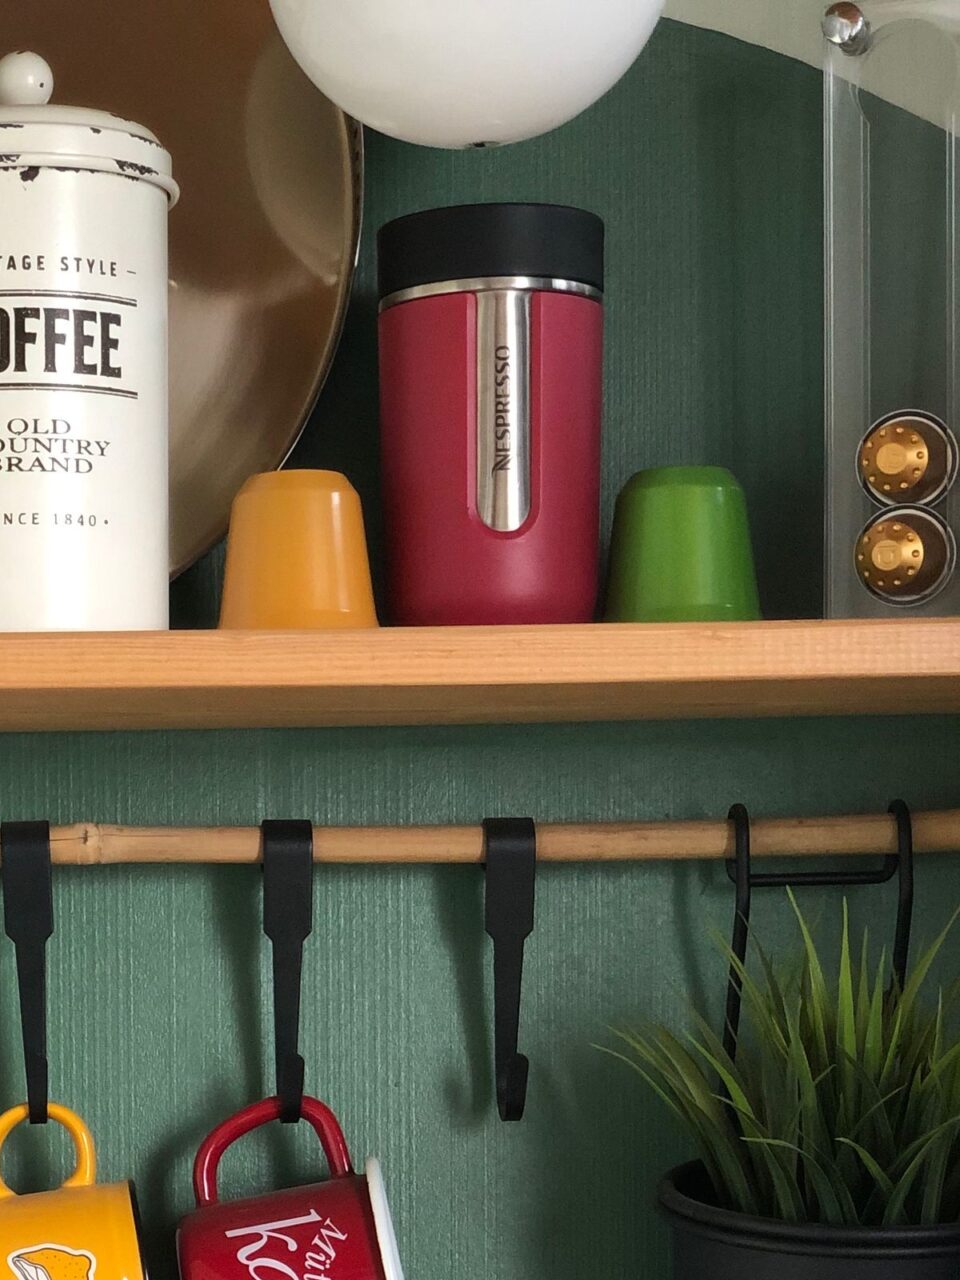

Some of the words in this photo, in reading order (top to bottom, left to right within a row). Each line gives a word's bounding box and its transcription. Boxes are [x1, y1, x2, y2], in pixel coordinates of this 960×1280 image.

[60, 256, 117, 277] STYLE
[491, 345, 511, 478] NESPRESSO
[7, 418, 71, 434] OLD
[53, 513, 97, 527] 1840
